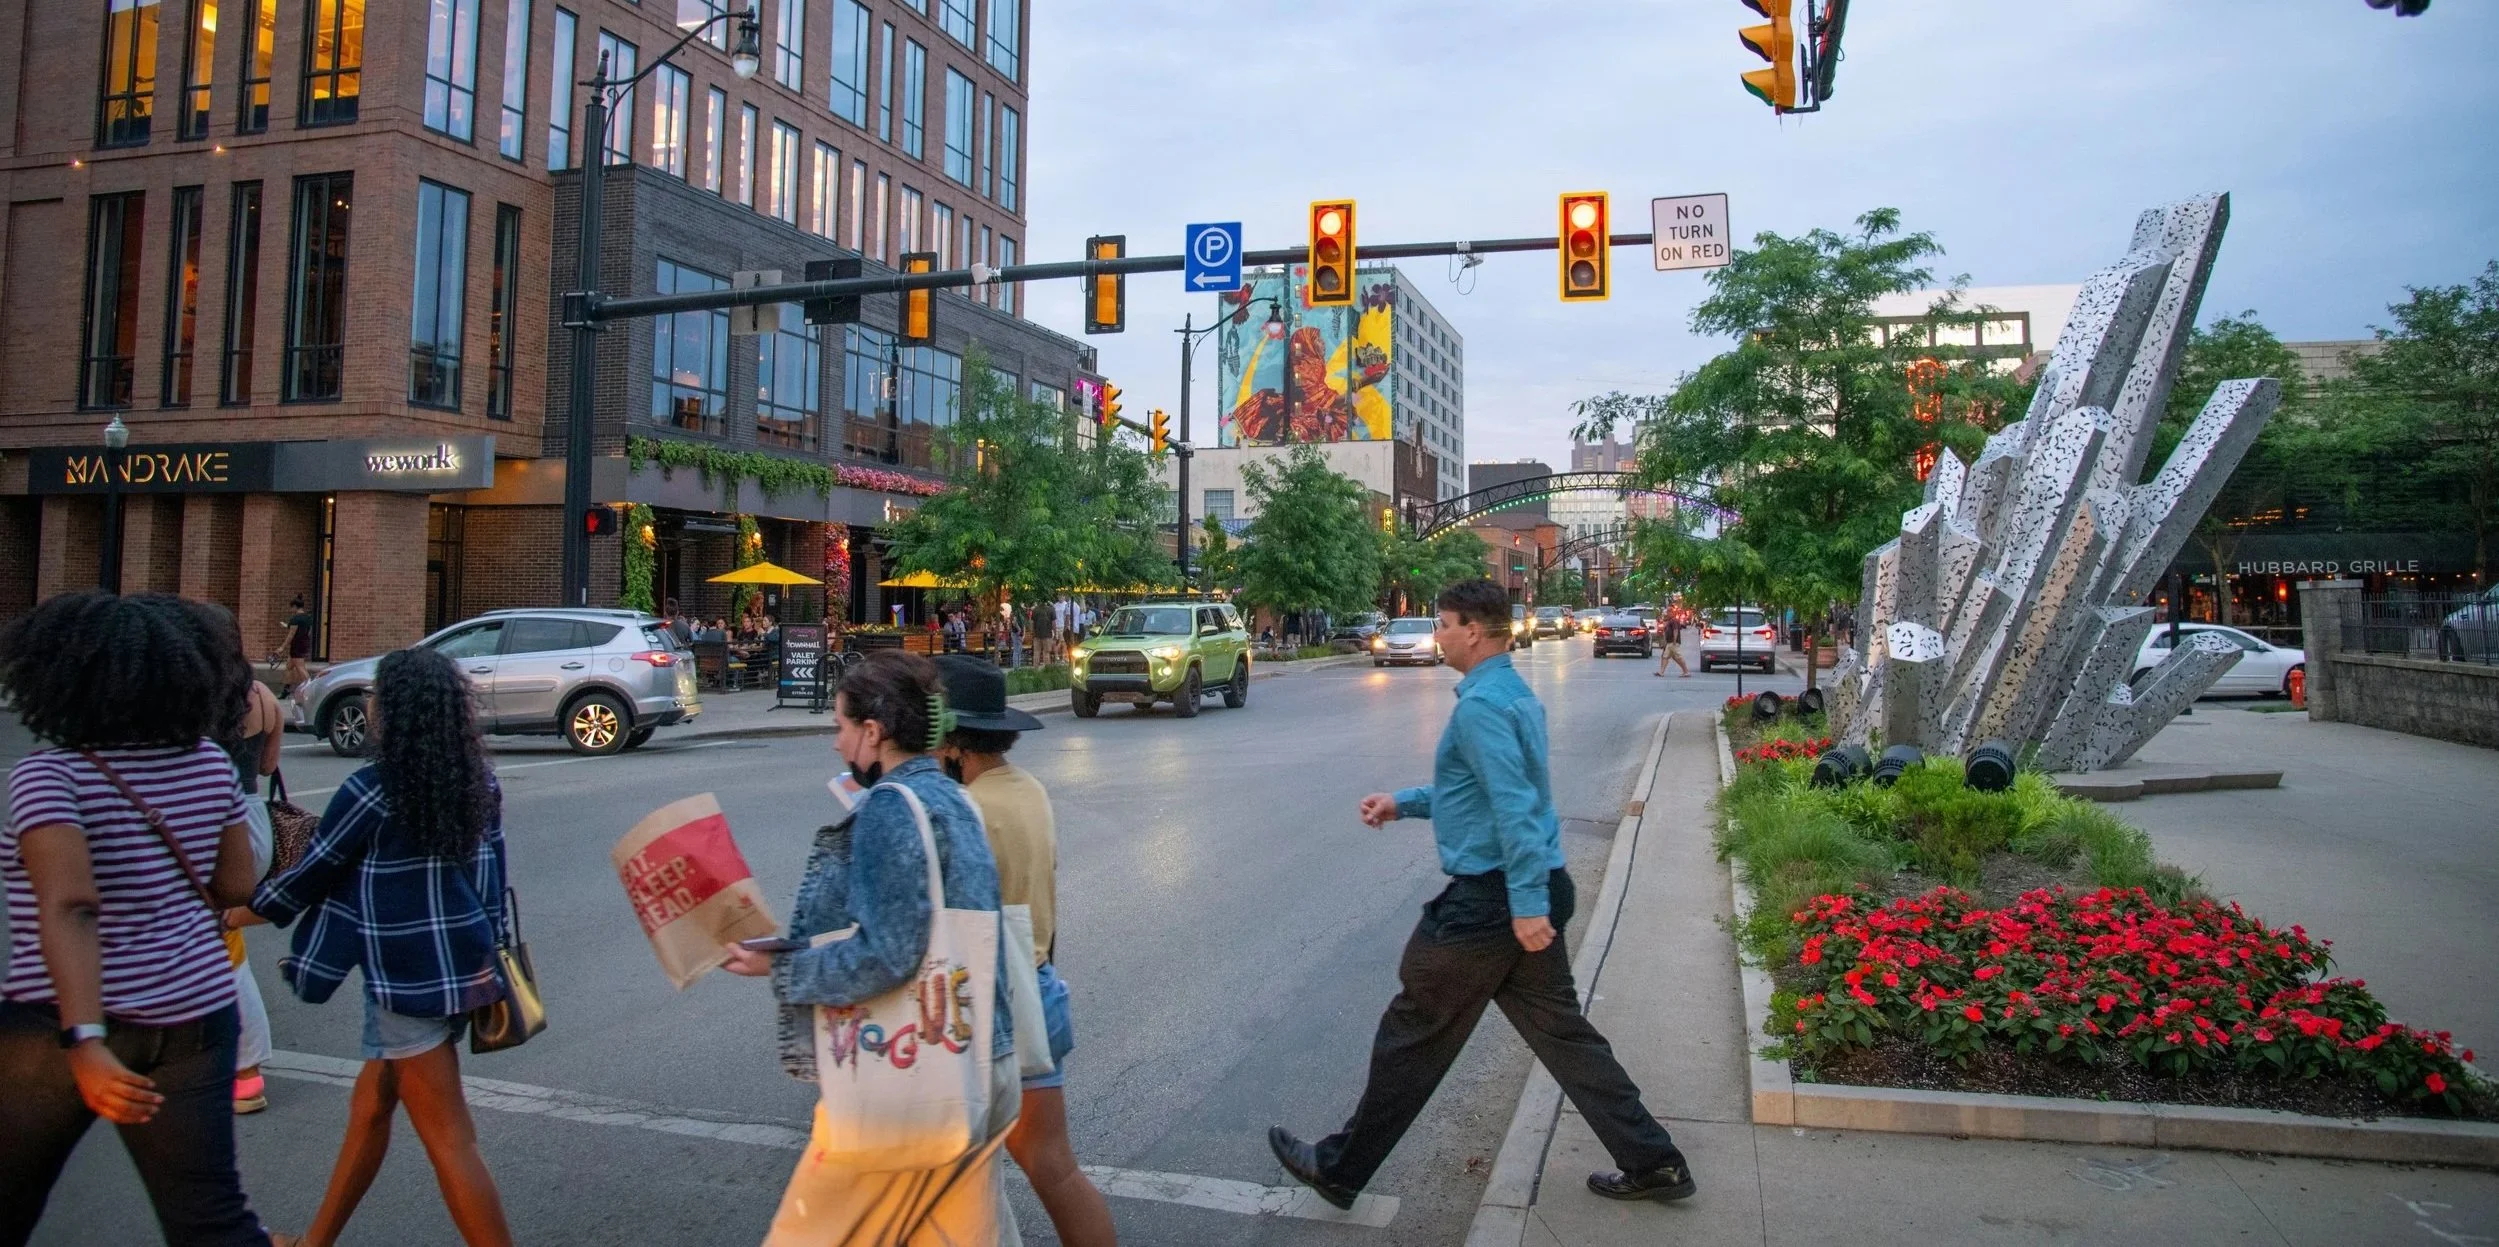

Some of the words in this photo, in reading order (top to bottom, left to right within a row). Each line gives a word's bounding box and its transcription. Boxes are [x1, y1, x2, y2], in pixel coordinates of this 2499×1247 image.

[1676, 204, 1704, 220] NO
[1669, 223, 1713, 240] TURN
[1661, 246, 1682, 261] ON
[1691, 243, 1724, 259] RED
[363, 443, 459, 473] wework
[66, 452, 229, 484] MANDRAKE
[2238, 561, 2340, 574] HUBBARD
[2349, 560, 2420, 573] GRILLE
[822, 966, 974, 1069] VOGUE
